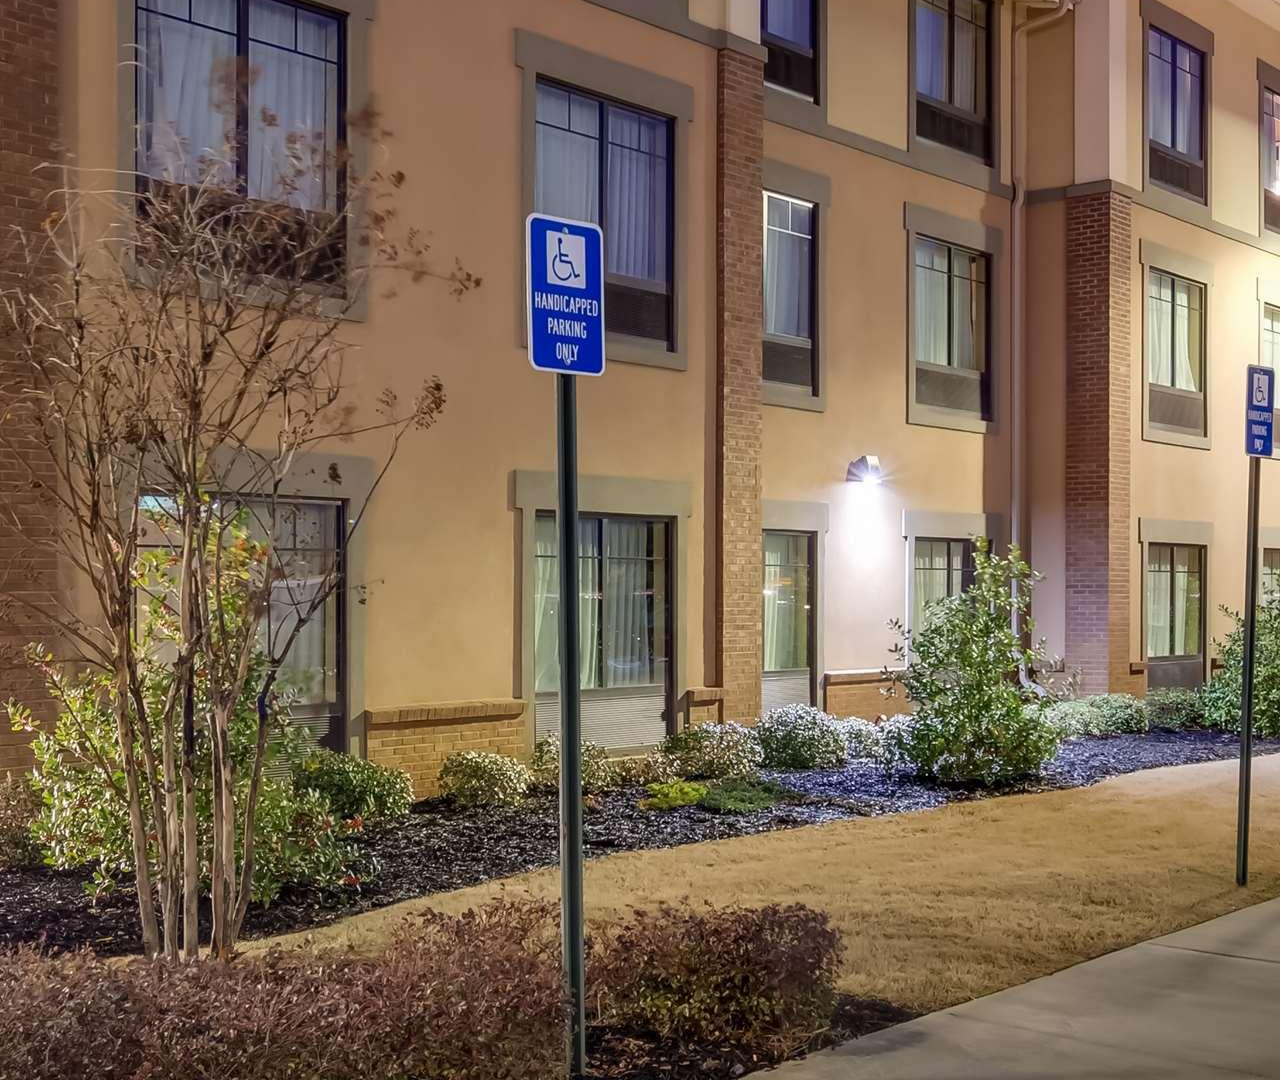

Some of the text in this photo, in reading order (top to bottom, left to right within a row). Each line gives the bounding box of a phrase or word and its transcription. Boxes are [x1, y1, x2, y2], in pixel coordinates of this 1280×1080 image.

[534, 291, 599, 317] HANDICAPPED
[547, 317, 587, 339] PARKING
[555, 342, 580, 361] ONLY
